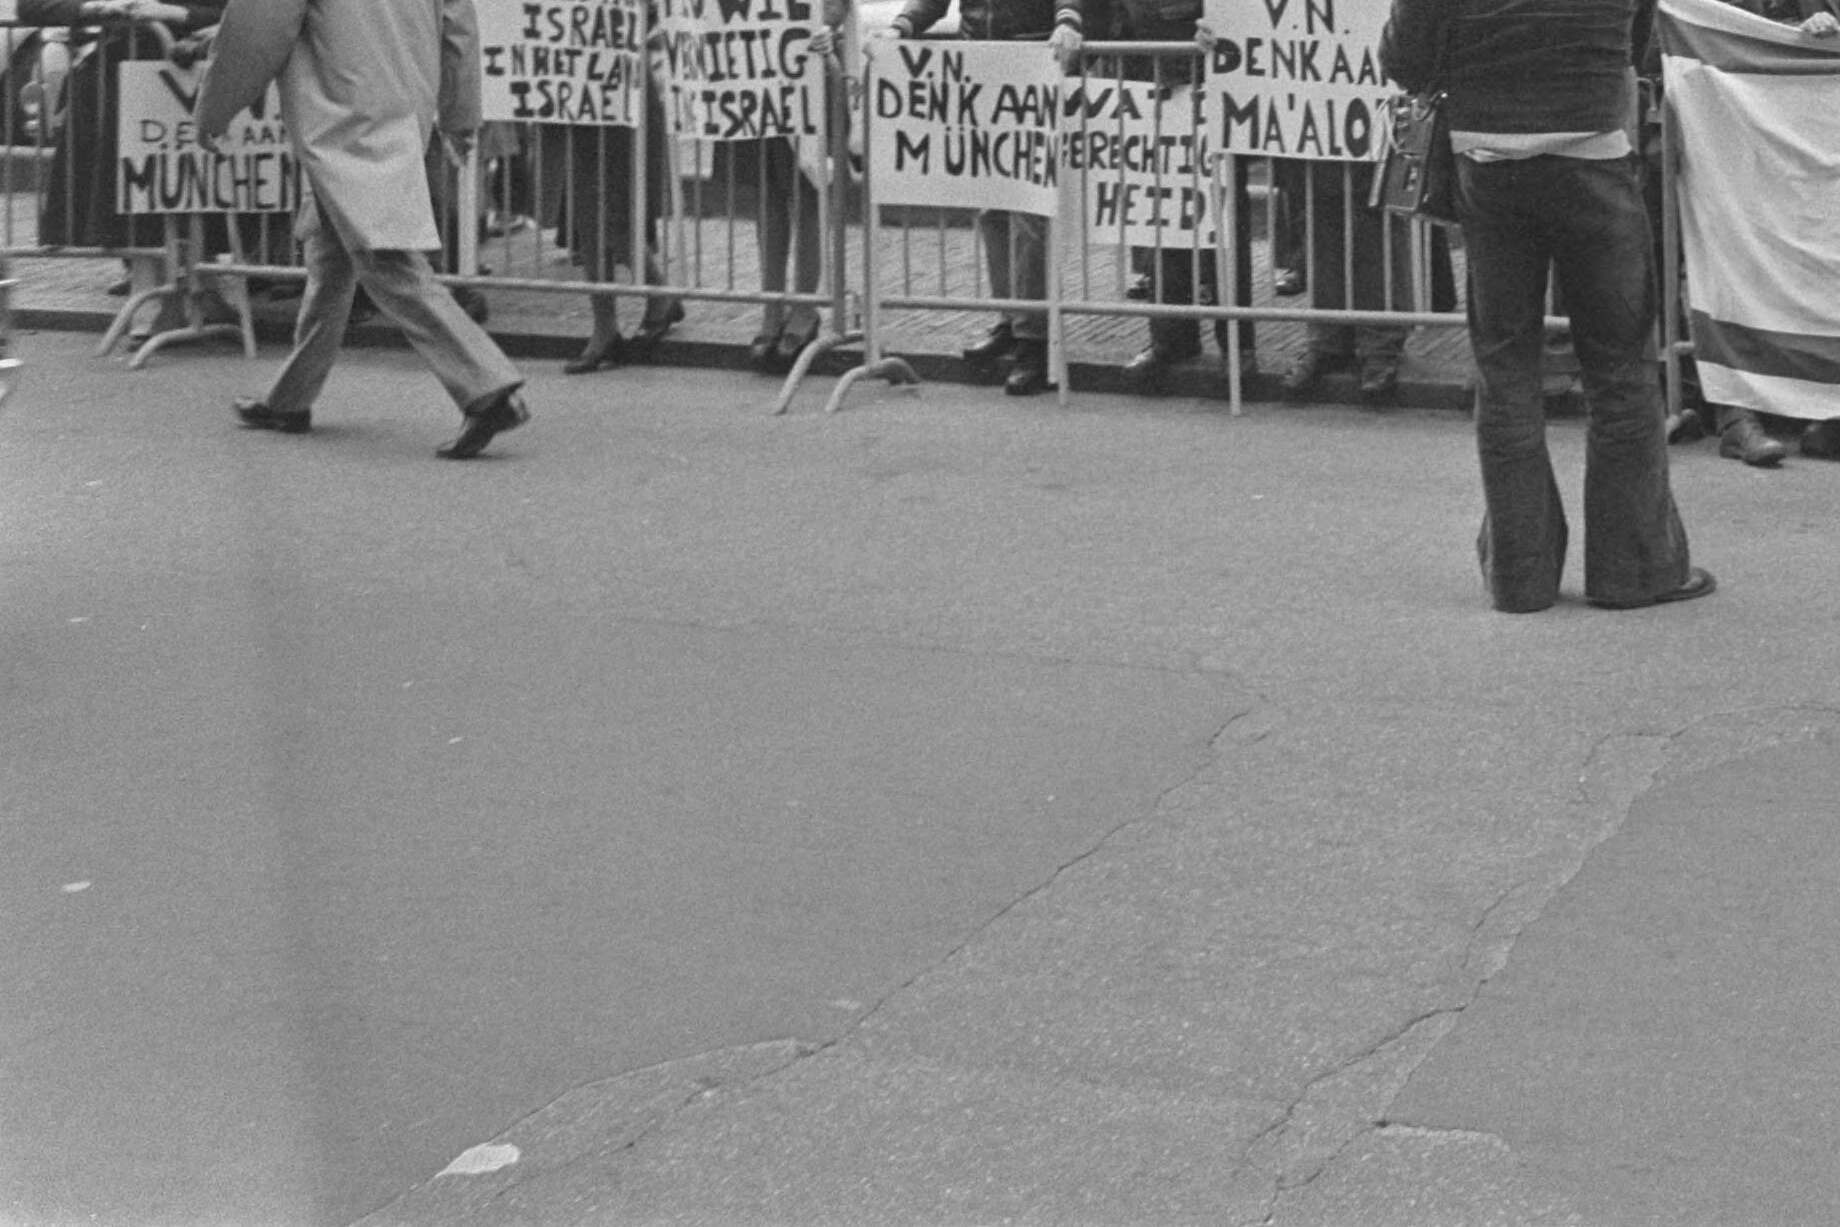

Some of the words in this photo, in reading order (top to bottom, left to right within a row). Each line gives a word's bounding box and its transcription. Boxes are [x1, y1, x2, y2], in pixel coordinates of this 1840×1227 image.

[523, 3, 638, 53] ISRAEL
[899, 44, 972, 84] V.N.
[1213, 37, 1321, 82] DENK
[1329, 43, 1387, 87] AA
[510, 79, 631, 121] ISRAEL
[701, 84, 817, 137] ISRAEL
[877, 77, 983, 128] DENK
[990, 83, 1058, 130] AAN
[895, 125, 1058, 188] MÜNCHEN
